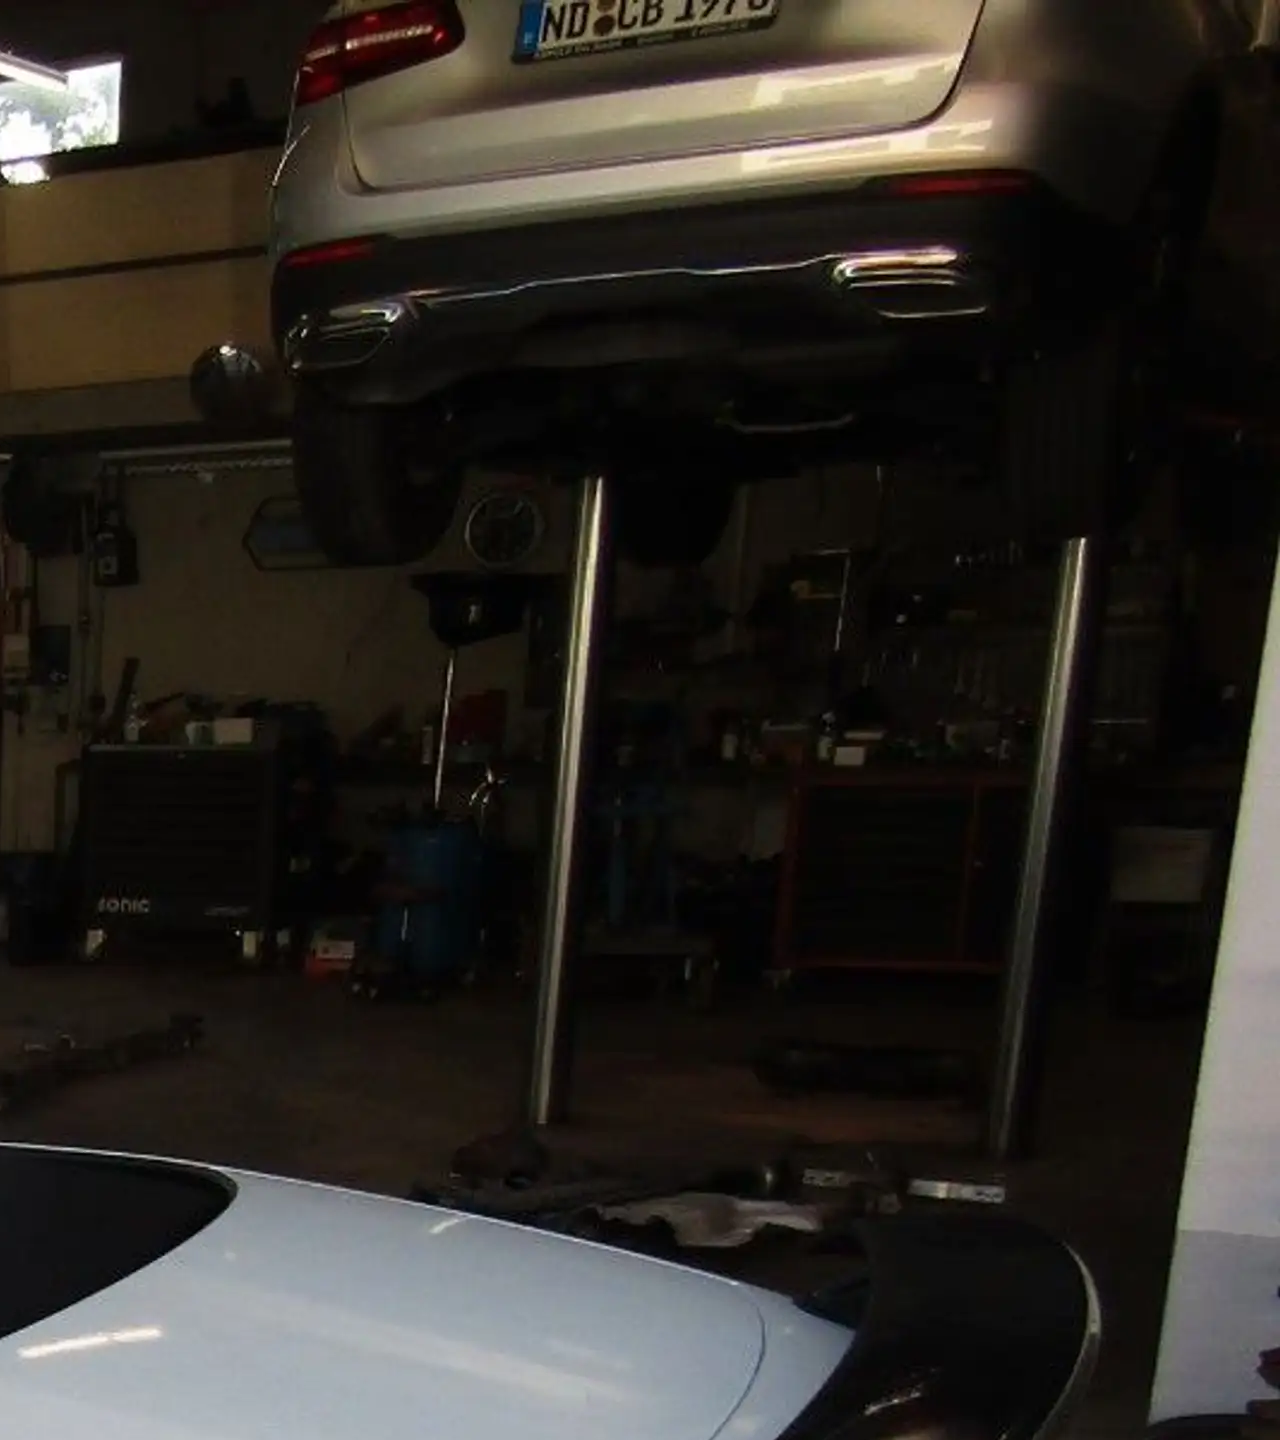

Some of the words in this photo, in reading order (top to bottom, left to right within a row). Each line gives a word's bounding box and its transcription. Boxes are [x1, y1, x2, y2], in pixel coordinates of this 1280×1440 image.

[542, 2, 589, 42] ND
[619, 0, 664, 29] CB
[674, 0, 767, 22] 19
